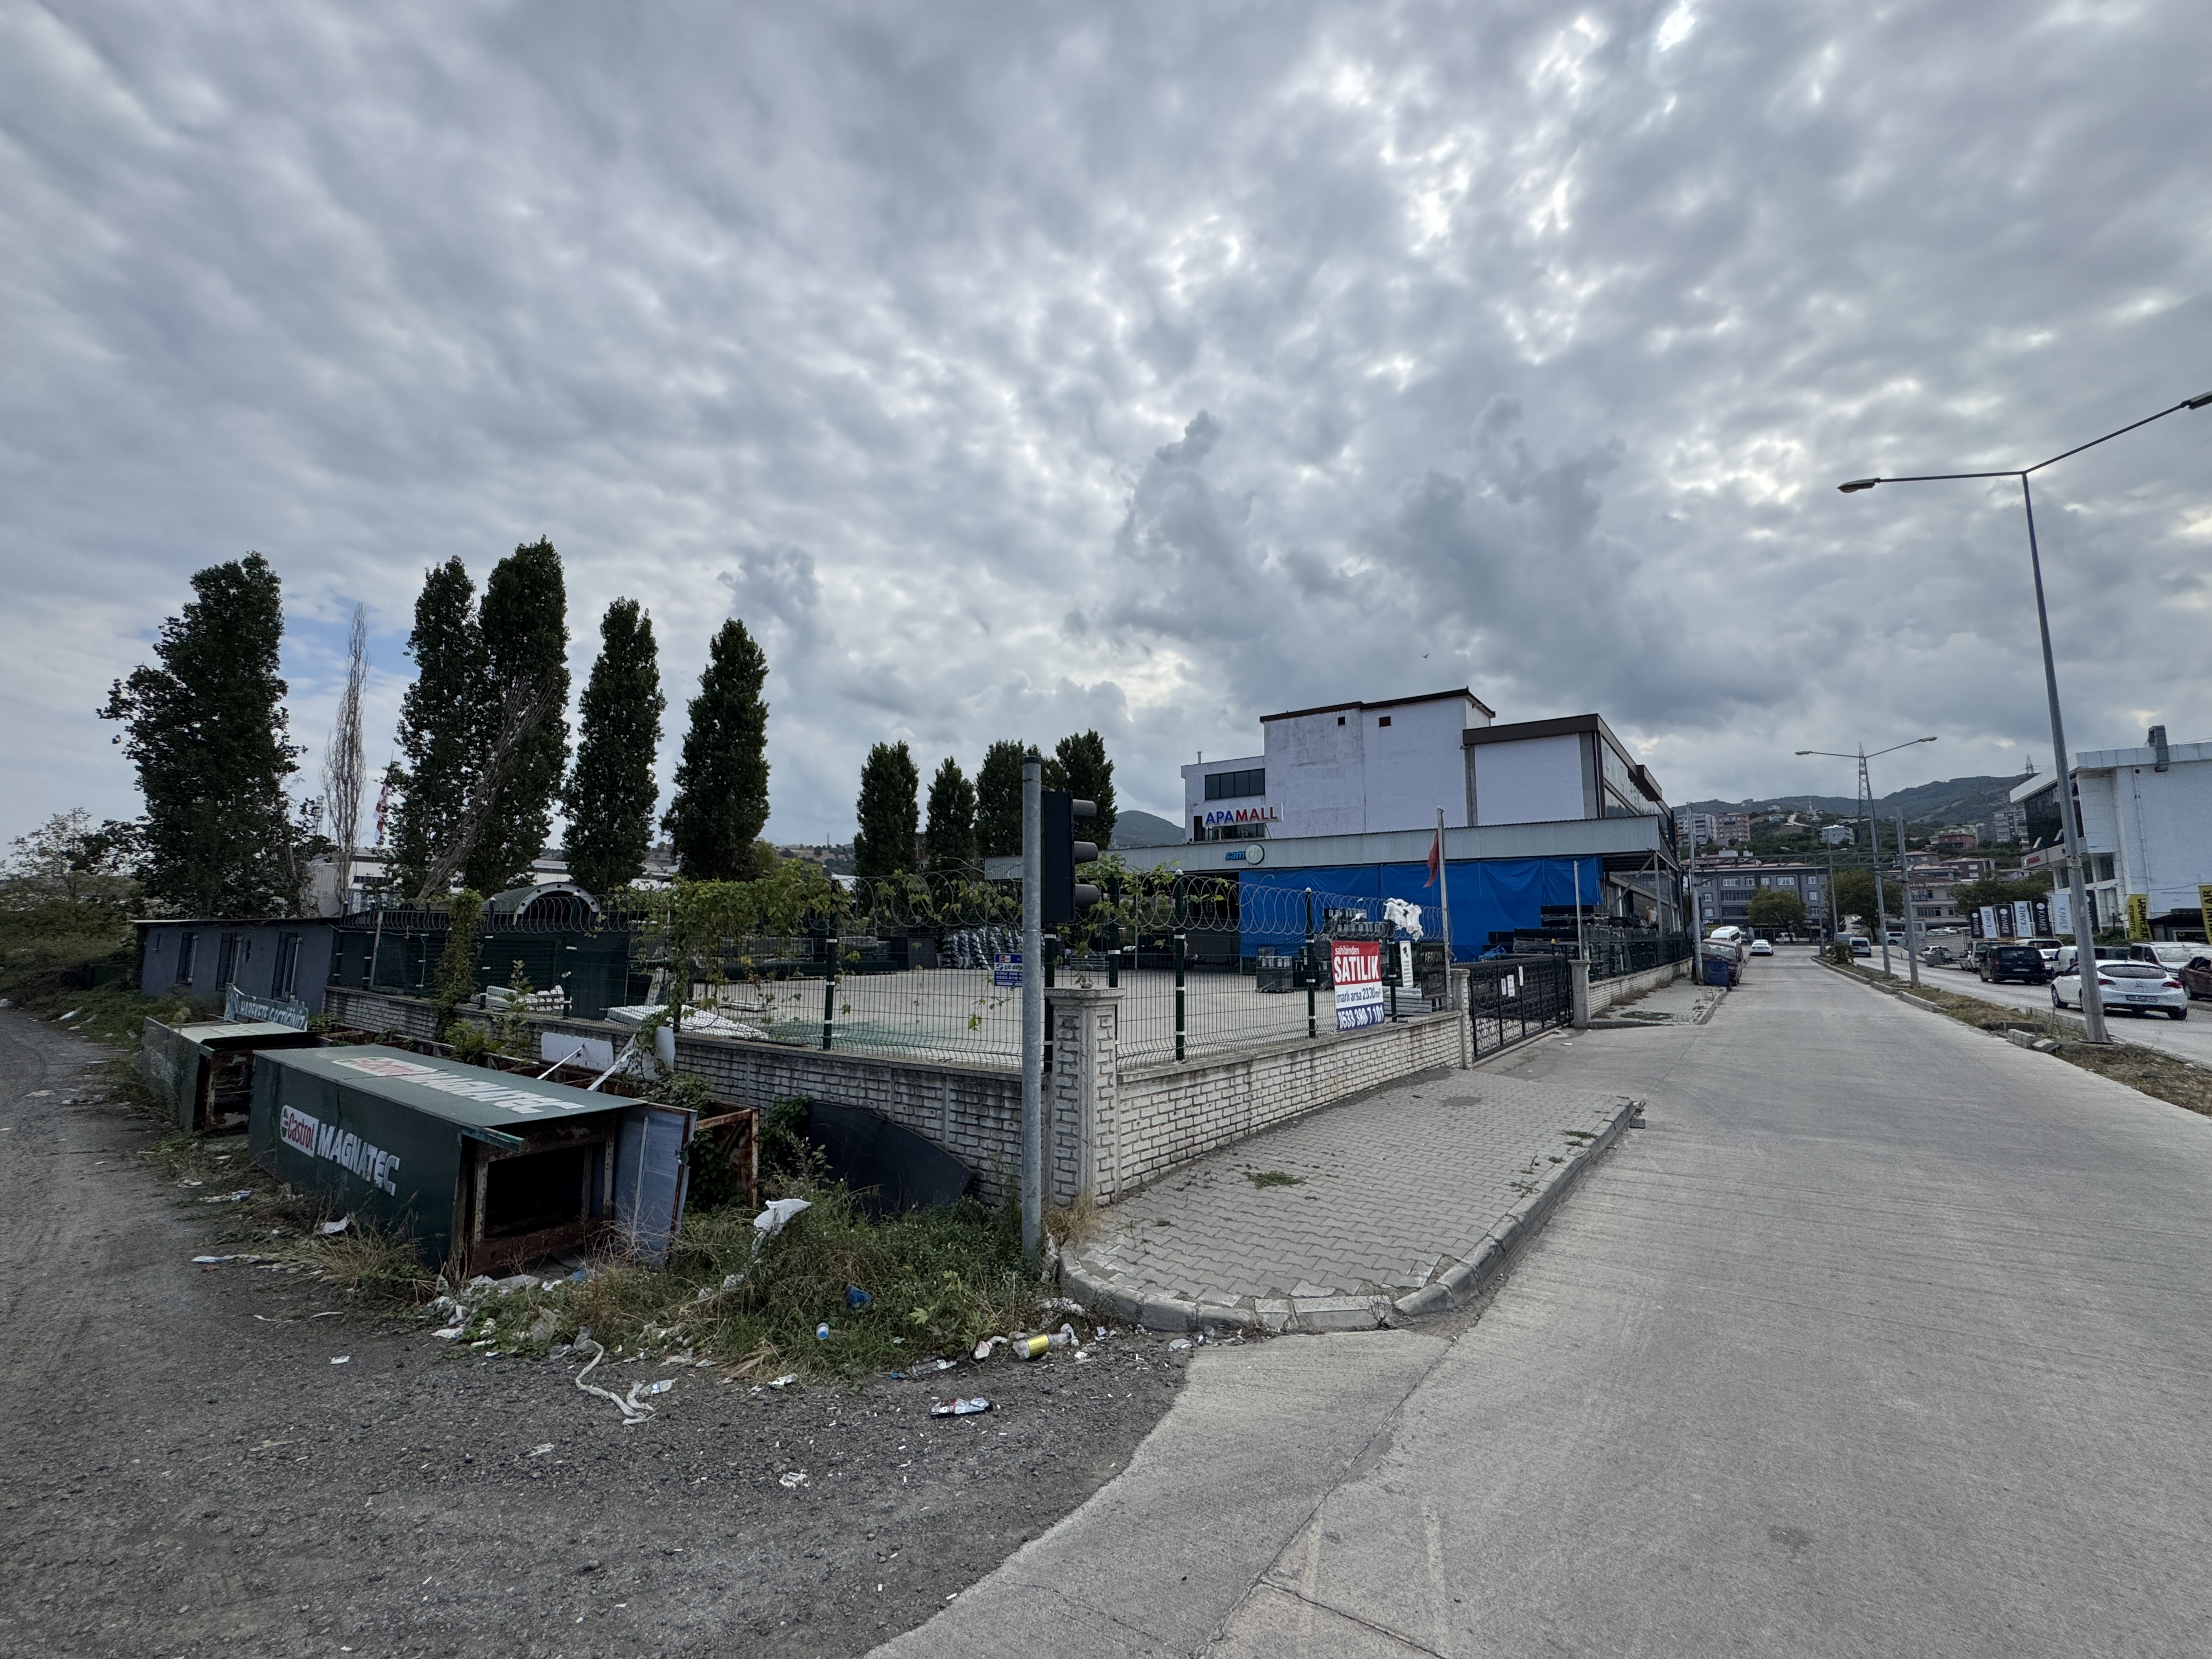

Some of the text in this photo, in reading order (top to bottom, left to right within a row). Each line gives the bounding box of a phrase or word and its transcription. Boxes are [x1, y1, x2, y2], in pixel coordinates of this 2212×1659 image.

[1205, 806, 1278, 825] APAMALL
[2019, 906, 2027, 926] KAMER
[2038, 910, 2048, 932] KAMER
[2058, 907, 2068, 929] KAMER
[1334, 955, 1380, 983] SATILIK
[1351, 992, 1362, 1002] arsa
[1362, 986, 1375, 1000] 2330
[1338, 1009, 1356, 1029] 0533
[1354, 1007, 1368, 1026] 380
[287, 1112, 400, 1197] Castrol MAGNATEC
